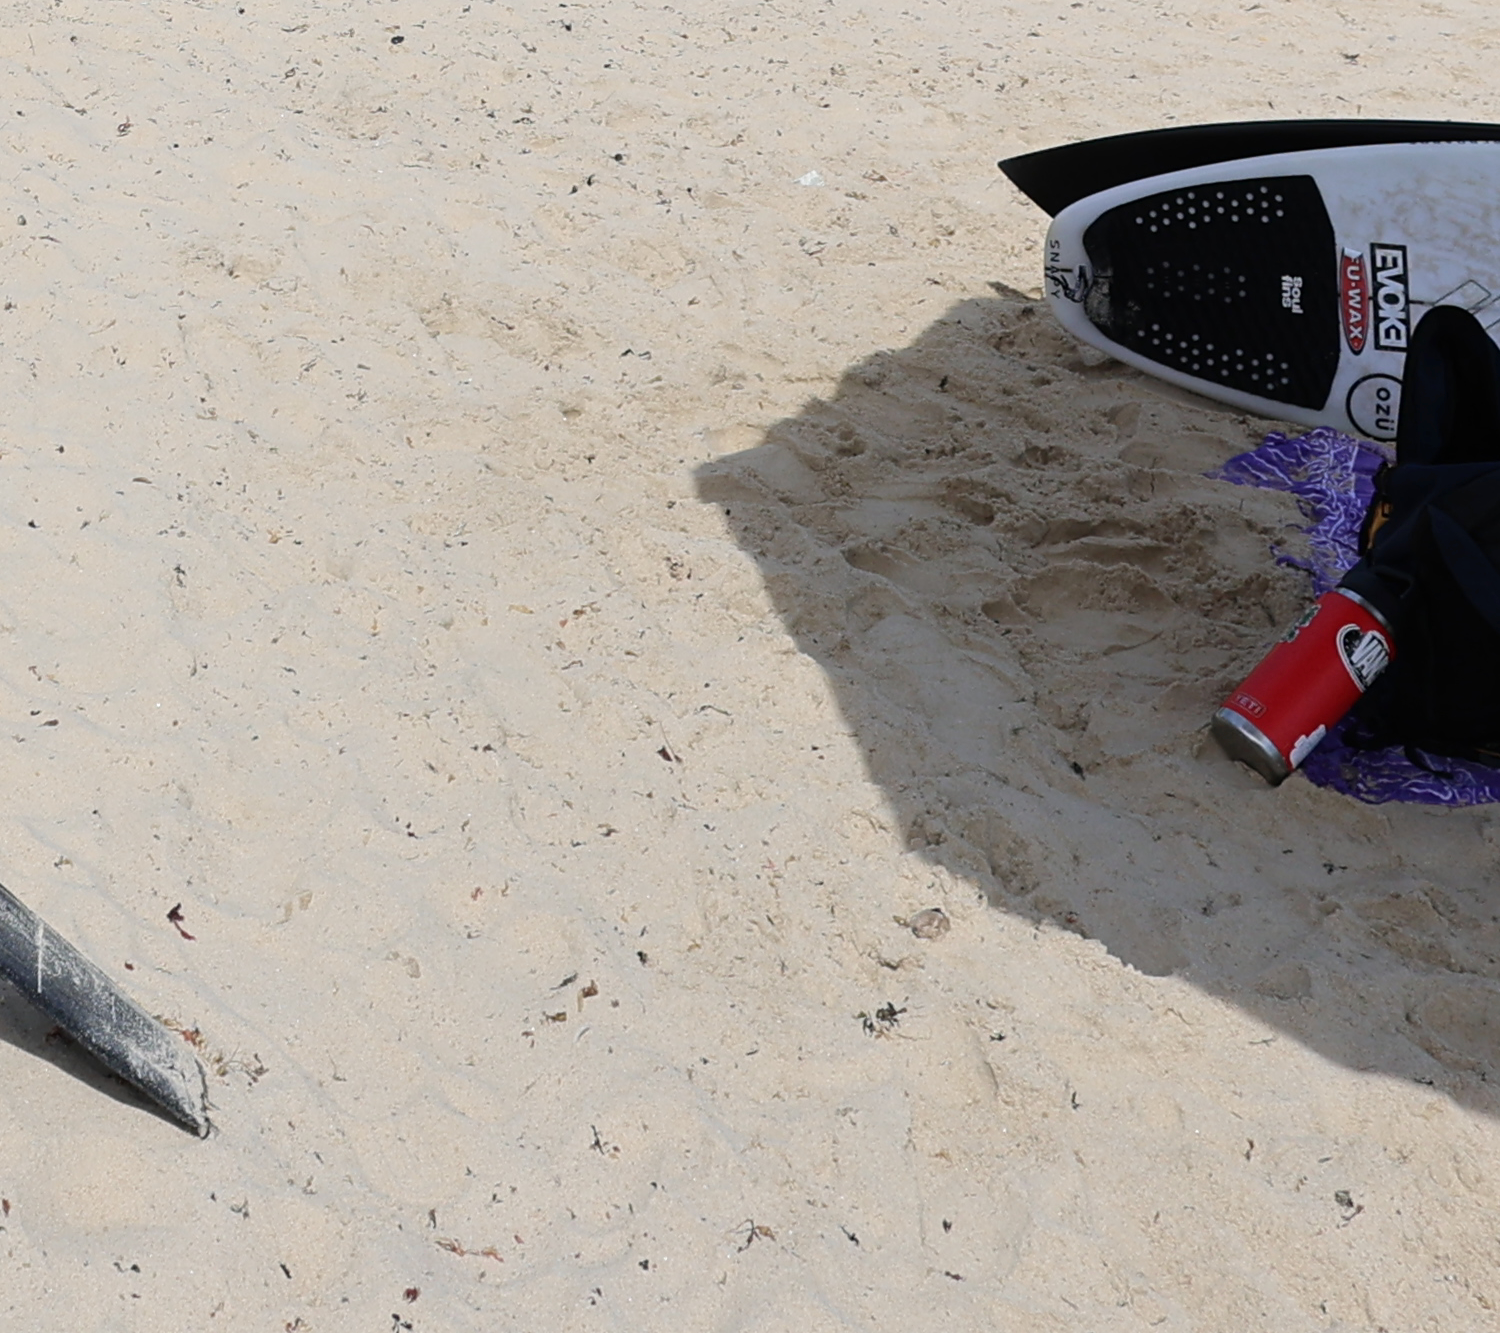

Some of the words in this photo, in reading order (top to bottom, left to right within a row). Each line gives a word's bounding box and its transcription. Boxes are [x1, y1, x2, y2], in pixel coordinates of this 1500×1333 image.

[1281, 275, 1292, 309] fins
[1292, 276, 1304, 315] Soul
[1235, 695, 1264, 715] YETI
